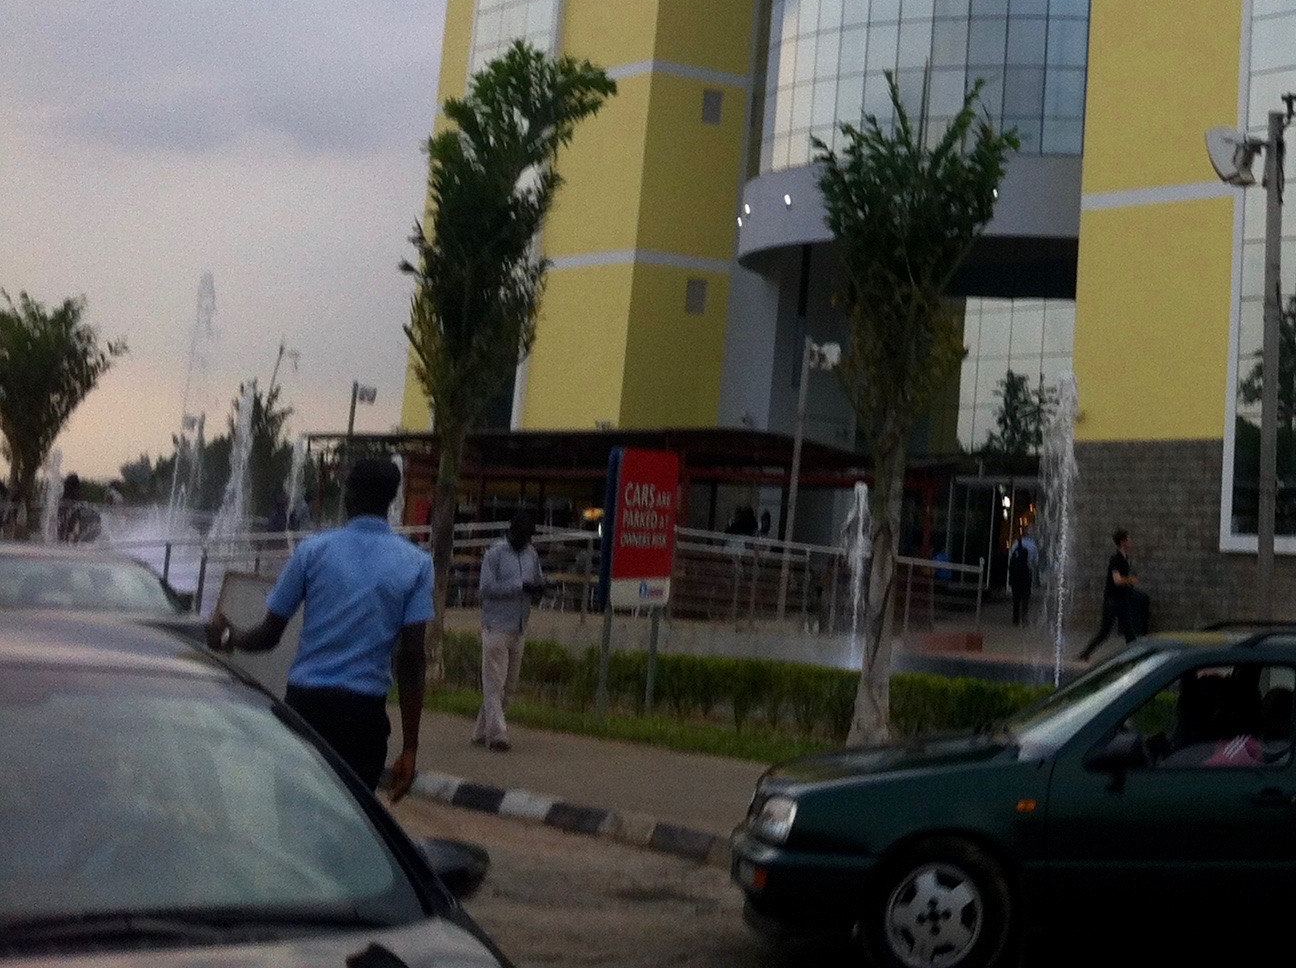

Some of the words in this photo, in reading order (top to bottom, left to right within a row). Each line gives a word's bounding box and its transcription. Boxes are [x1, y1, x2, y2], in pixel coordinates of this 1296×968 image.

[625, 482, 655, 508] CARS
[656, 491, 672, 507] ARE
[622, 508, 657, 529] PARKED
